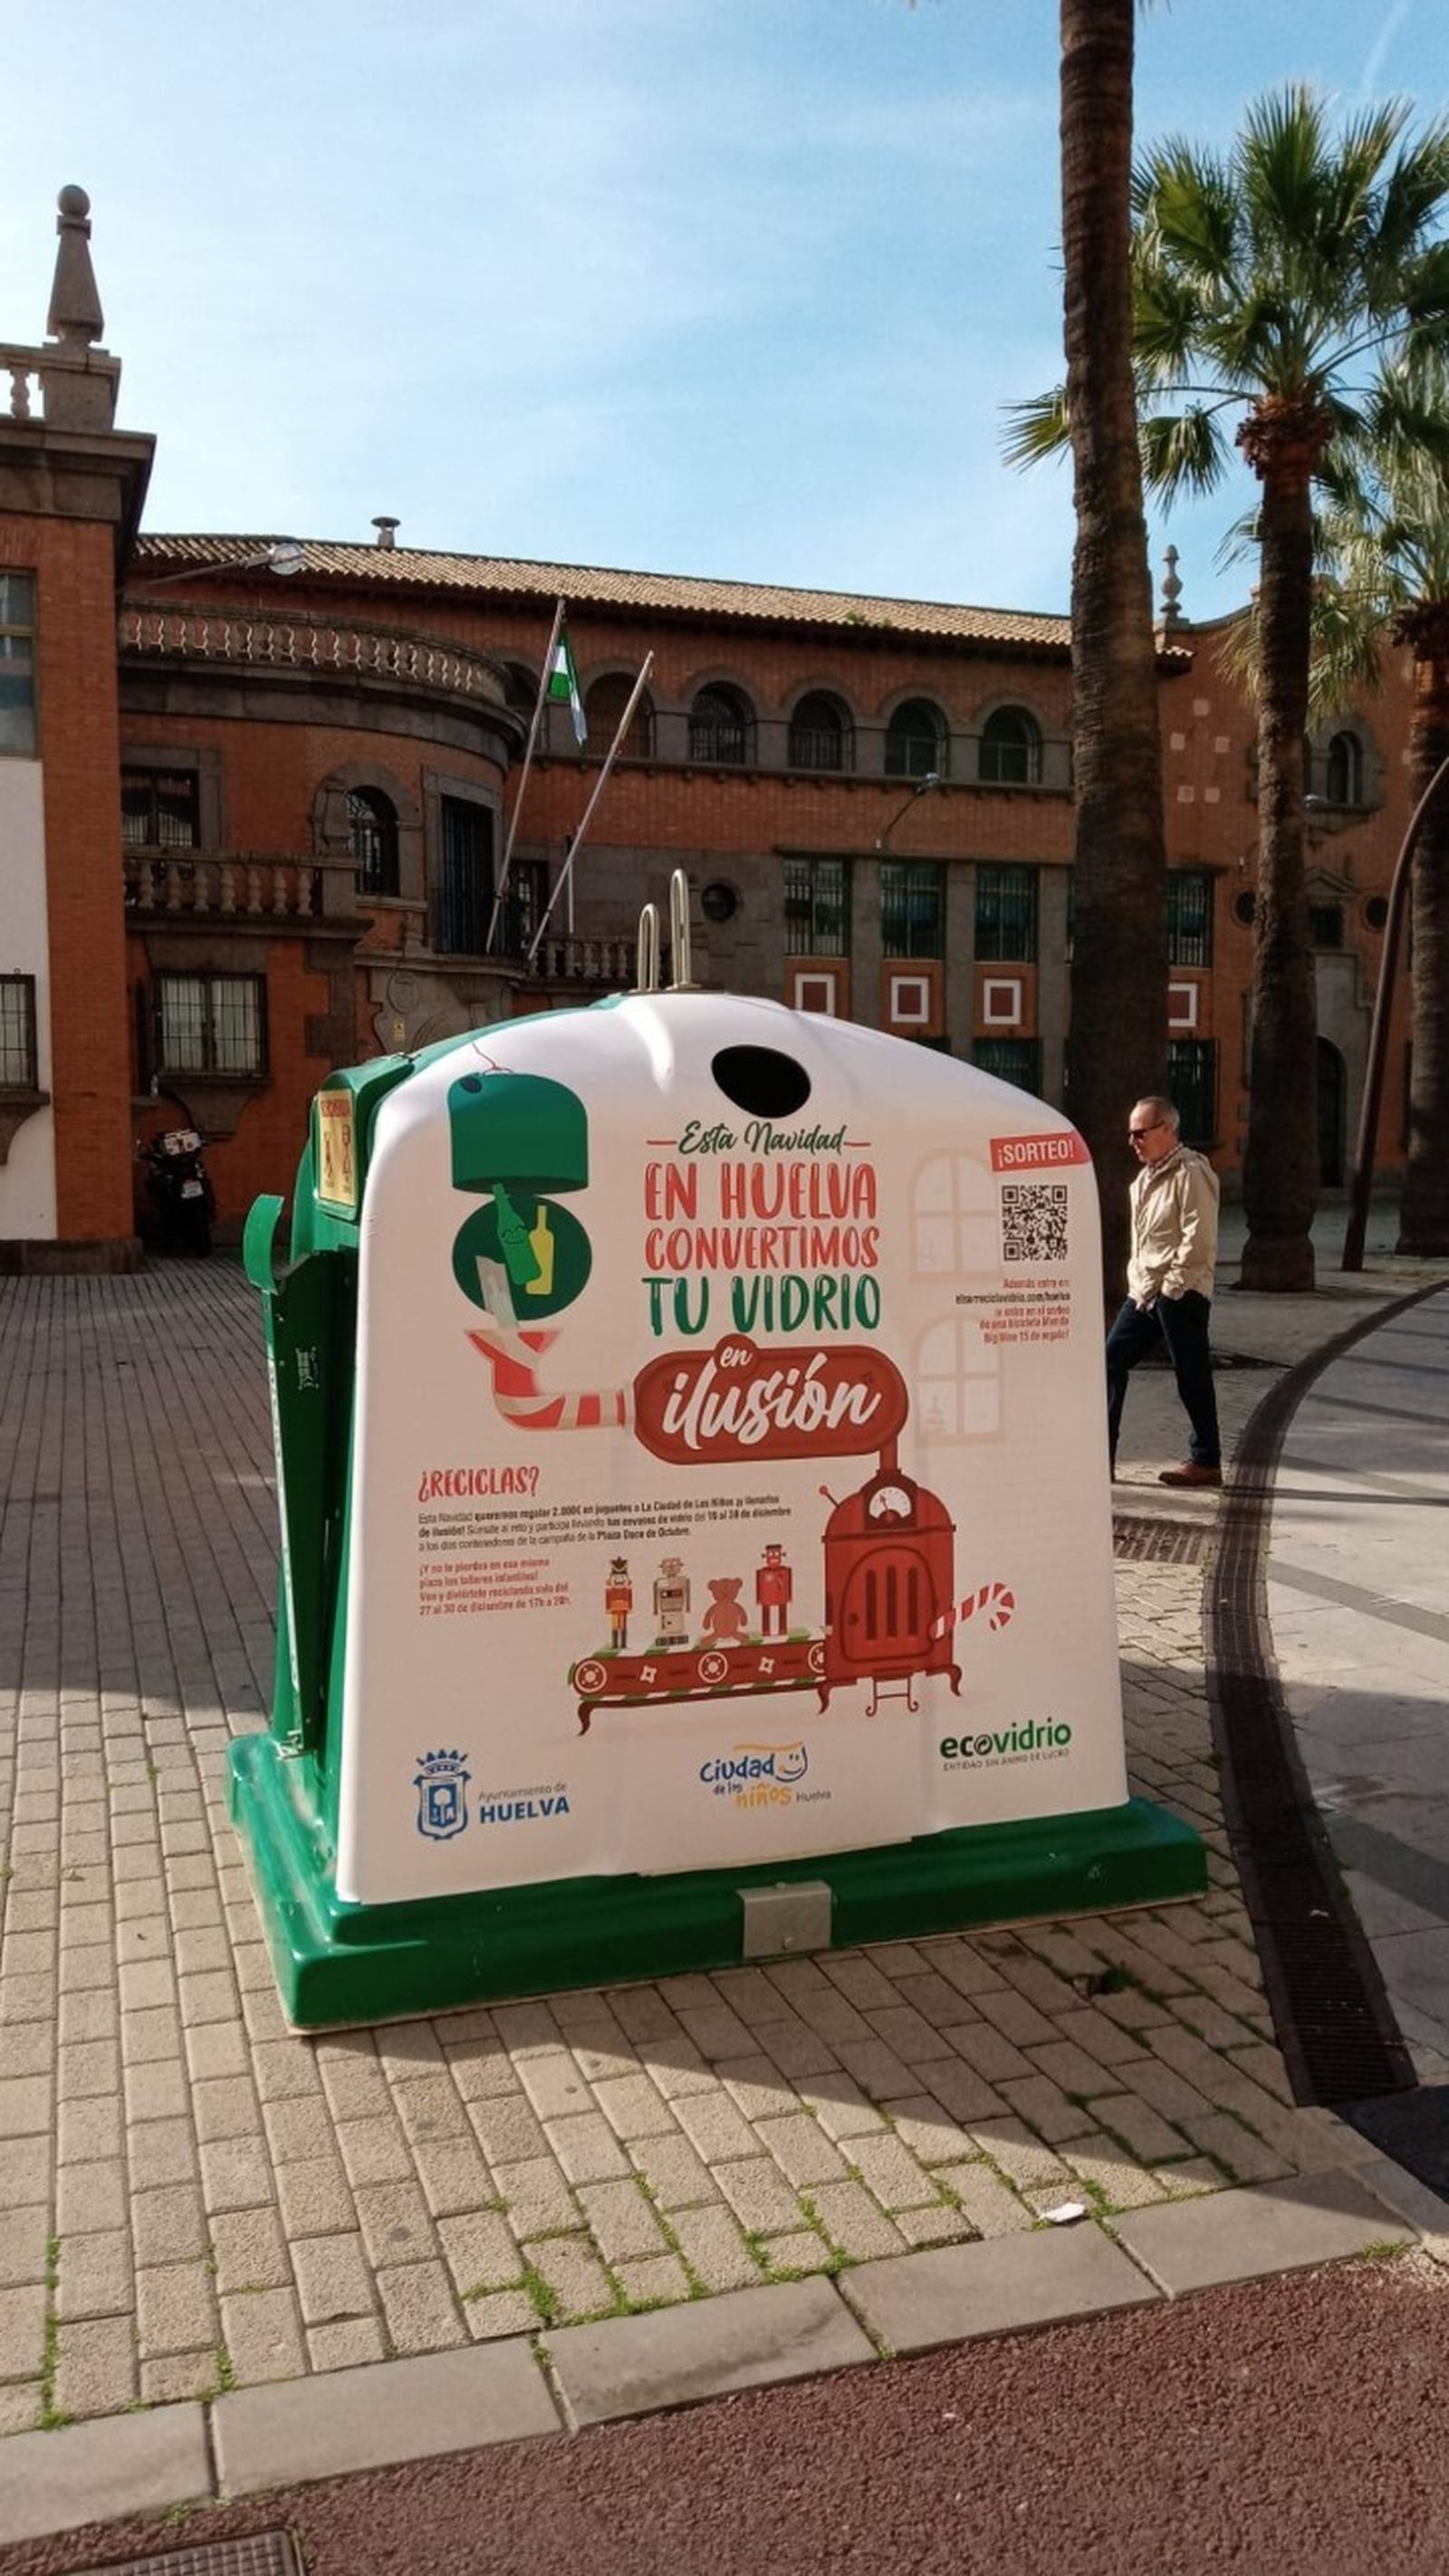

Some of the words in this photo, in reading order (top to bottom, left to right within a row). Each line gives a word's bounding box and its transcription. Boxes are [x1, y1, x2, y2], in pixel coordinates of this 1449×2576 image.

[678, 1121, 738, 1155] Esta
[745, 1121, 847, 1156] Navidad
[998, 1139, 1074, 1168] ¡SORTEO!
[645, 1162, 696, 1221] EN
[724, 1162, 878, 1220] HUELVA
[645, 1226, 880, 1271] CONVERTIMOS
[642, 1276, 710, 1336] TU
[732, 1274, 881, 1333] VIDRIO
[719, 1345, 752, 1368] en
[662, 1352, 881, 1450] ilusión
[418, 1466, 540, 1502] ¿RECICLAS?
[418, 1514, 437, 1523] Esta
[439, 1513, 473, 1522] Navidad
[475, 1510, 518, 1521] queremos
[582, 1505, 593, 1514] en
[595, 1504, 632, 1514] juguetes
[642, 1503, 651, 1512] La
[654, 1500, 681, 1511] Ciudad
[684, 1499, 693, 1508] de
[711, 1497, 734, 1506] Niños
[419, 1527, 429, 1538] de
[608, 1517, 620, 1526] tus
[623, 1515, 656, 1525] envases
[658, 1515, 667, 1523] de
[670, 1514, 692, 1523] vidrio
[695, 1512, 706, 1522] del
[741, 1509, 750, 1517] de
[753, 1507, 791, 1517] diciembre
[427, 1542, 439, 1551] los
[517, 1537, 527, 1545] de
[530, 1536, 537, 1544] la
[598, 1532, 621, 1540] Plaza
[624, 1530, 644, 1540] Doce
[647, 1529, 656, 1538] de
[940, 1716, 1071, 1758] ecovidrio
[944, 1761, 983, 1771] ENTIDAD
[478, 1785, 552, 1802] Ayuntamiento
[554, 1782, 568, 1792] de
[714, 1783, 724, 1794] de
[728, 1782, 743, 1793] los
[736, 1783, 792, 1808] niños
[796, 1791, 831, 1802] Huelva
[480, 1797, 570, 1824] HUELVA
